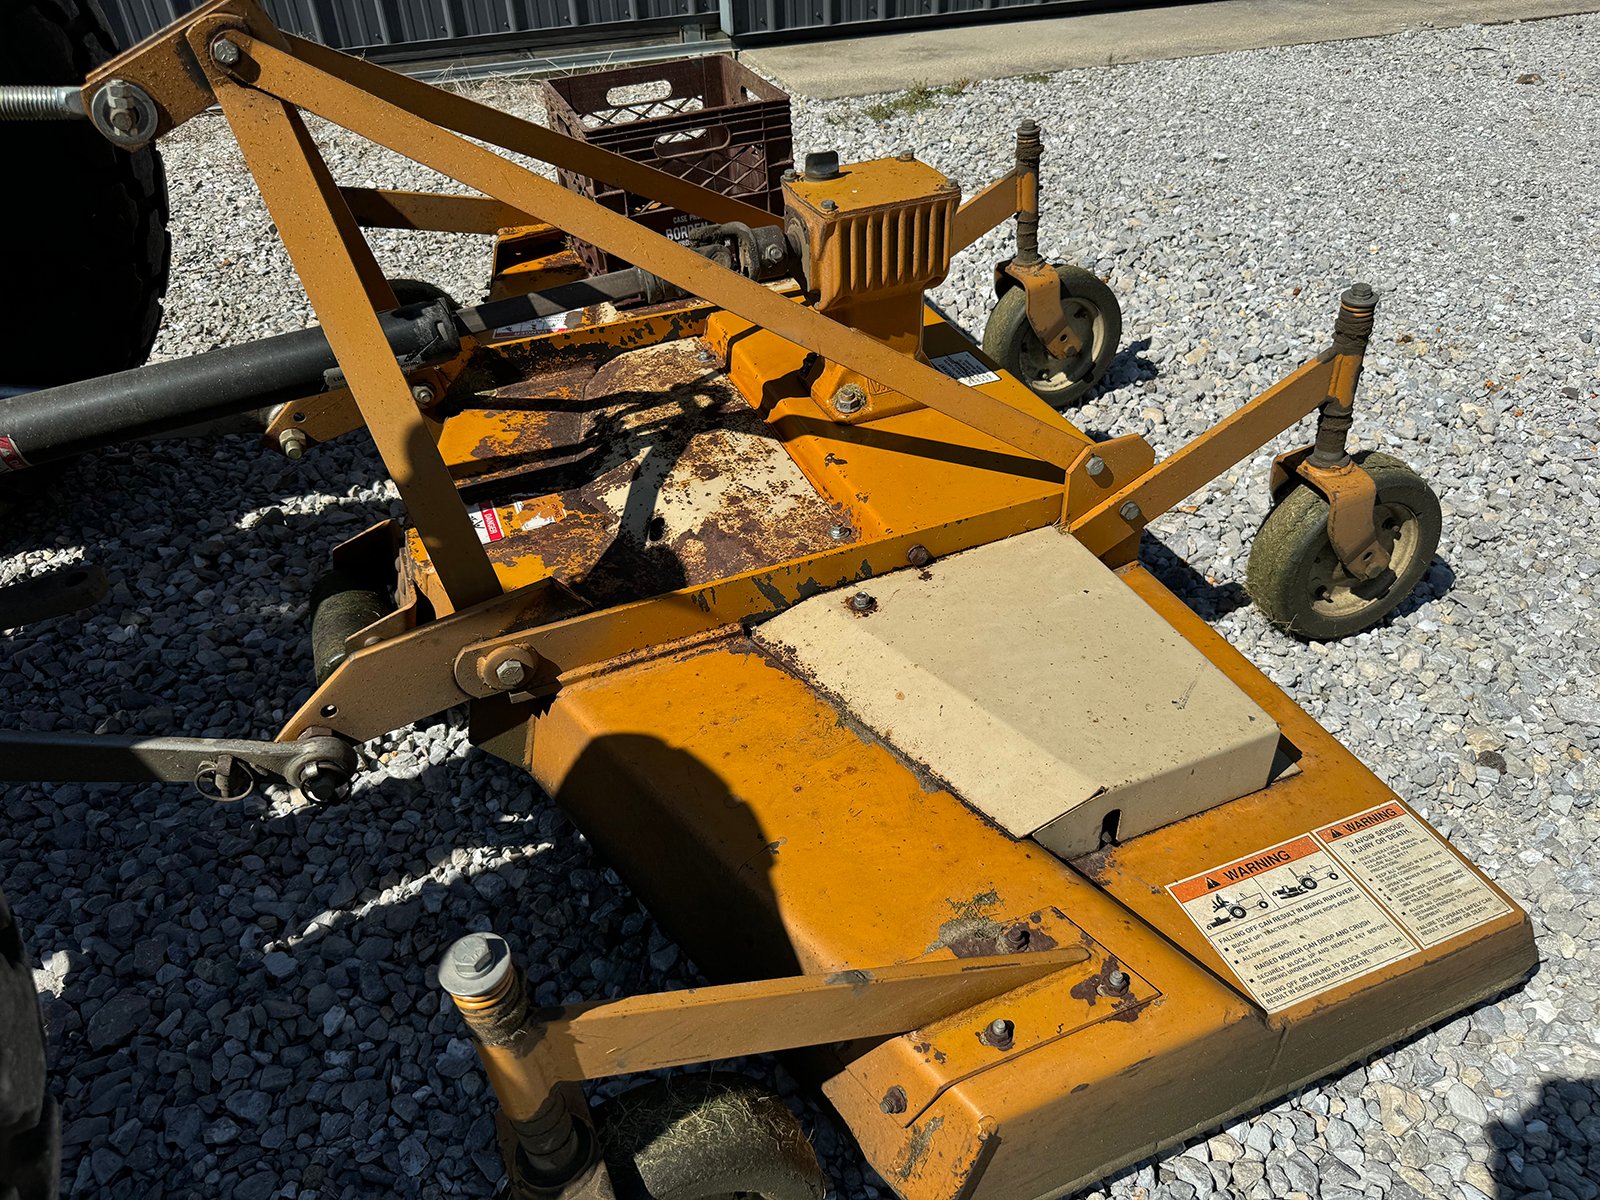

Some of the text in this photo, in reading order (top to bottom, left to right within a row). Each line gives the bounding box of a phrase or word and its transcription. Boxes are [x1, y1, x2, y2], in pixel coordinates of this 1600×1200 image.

[672, 214, 688, 224] CASE
[484, 513, 498, 535] DANGER
[1342, 807, 1397, 833] WARNING
[1342, 821, 1405, 849] TO AVOID SERIOUS
[1349, 827, 1412, 855] INJURY OR DEATH,
[1222, 849, 1292, 881] WARNING
[1217, 930, 1246, 944] FALLING
[1243, 924, 1259, 933] OFF
[1256, 918, 1273, 928] CAN
[1271, 909, 1297, 922] RESULT
[1302, 898, 1324, 910] BEING
[1321, 893, 1337, 902] RUN
[1334, 886, 1354, 897] OVER
[1230, 937, 1254, 949] BUCKLE
[1262, 923, 1289, 936] TRACTOR
[1286, 914, 1309, 926] SHOULD
[1307, 909, 1324, 917] HAVE
[1321, 903, 1338, 912] ROPS
[1335, 898, 1349, 906] AND
[1346, 893, 1361, 902] SEAT
[1240, 950, 1262, 961] ALLOW
[1253, 919, 1371, 970] RAISED MOWER CAN DROP AND CRUSH
[1255, 965, 1286, 980] SECURELY
[1286, 956, 1307, 967] BLOCK
[1316, 946, 1330, 954] AND
[1329, 936, 1354, 949] REMOVE
[1353, 931, 1366, 939] KEY
[1365, 922, 1389, 934] BEFORE
[1260, 984, 1286, 998] FALLING
[1284, 979, 1299, 988] OFF
[1307, 965, 1331, 978] FAILING
[1339, 953, 1361, 965] BLOCK
[1359, 941, 1390, 956] SECURELY
[1388, 936, 1402, 944] CAN
[1260, 971, 1288, 985] WORKING
[1264, 991, 1289, 1004] RESULT
[1294, 978, 1321, 992] SERIOUS
[1319, 969, 1341, 981] INJURY
[1339, 965, 1350, 973] OR
